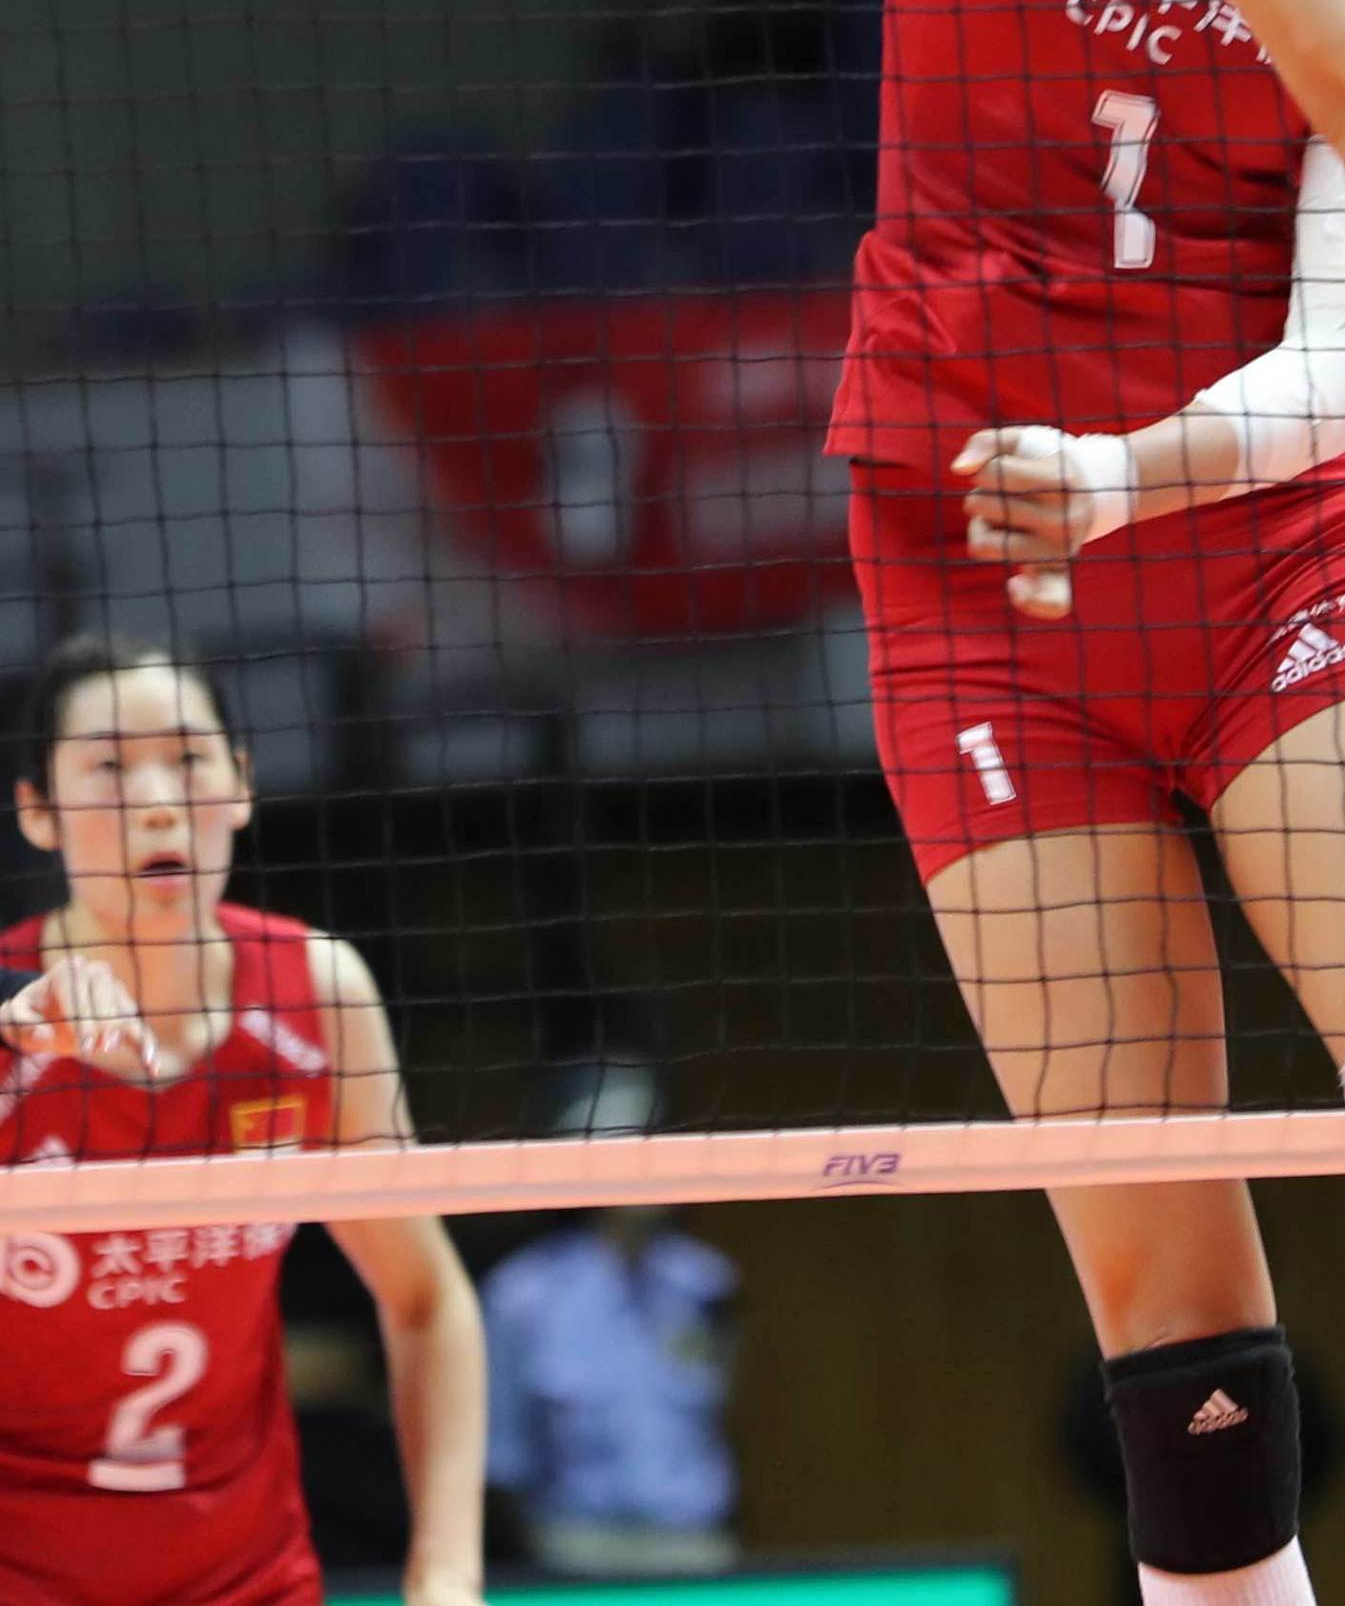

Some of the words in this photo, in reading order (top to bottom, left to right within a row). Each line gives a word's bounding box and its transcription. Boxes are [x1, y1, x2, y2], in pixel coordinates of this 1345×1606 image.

[1091, 89, 1160, 269] 1
[957, 721, 1017, 807] 1
[822, 1152, 901, 1177] FIVB
[86, 1271, 188, 1310] CPIC
[87, 1320, 209, 1493] 2
